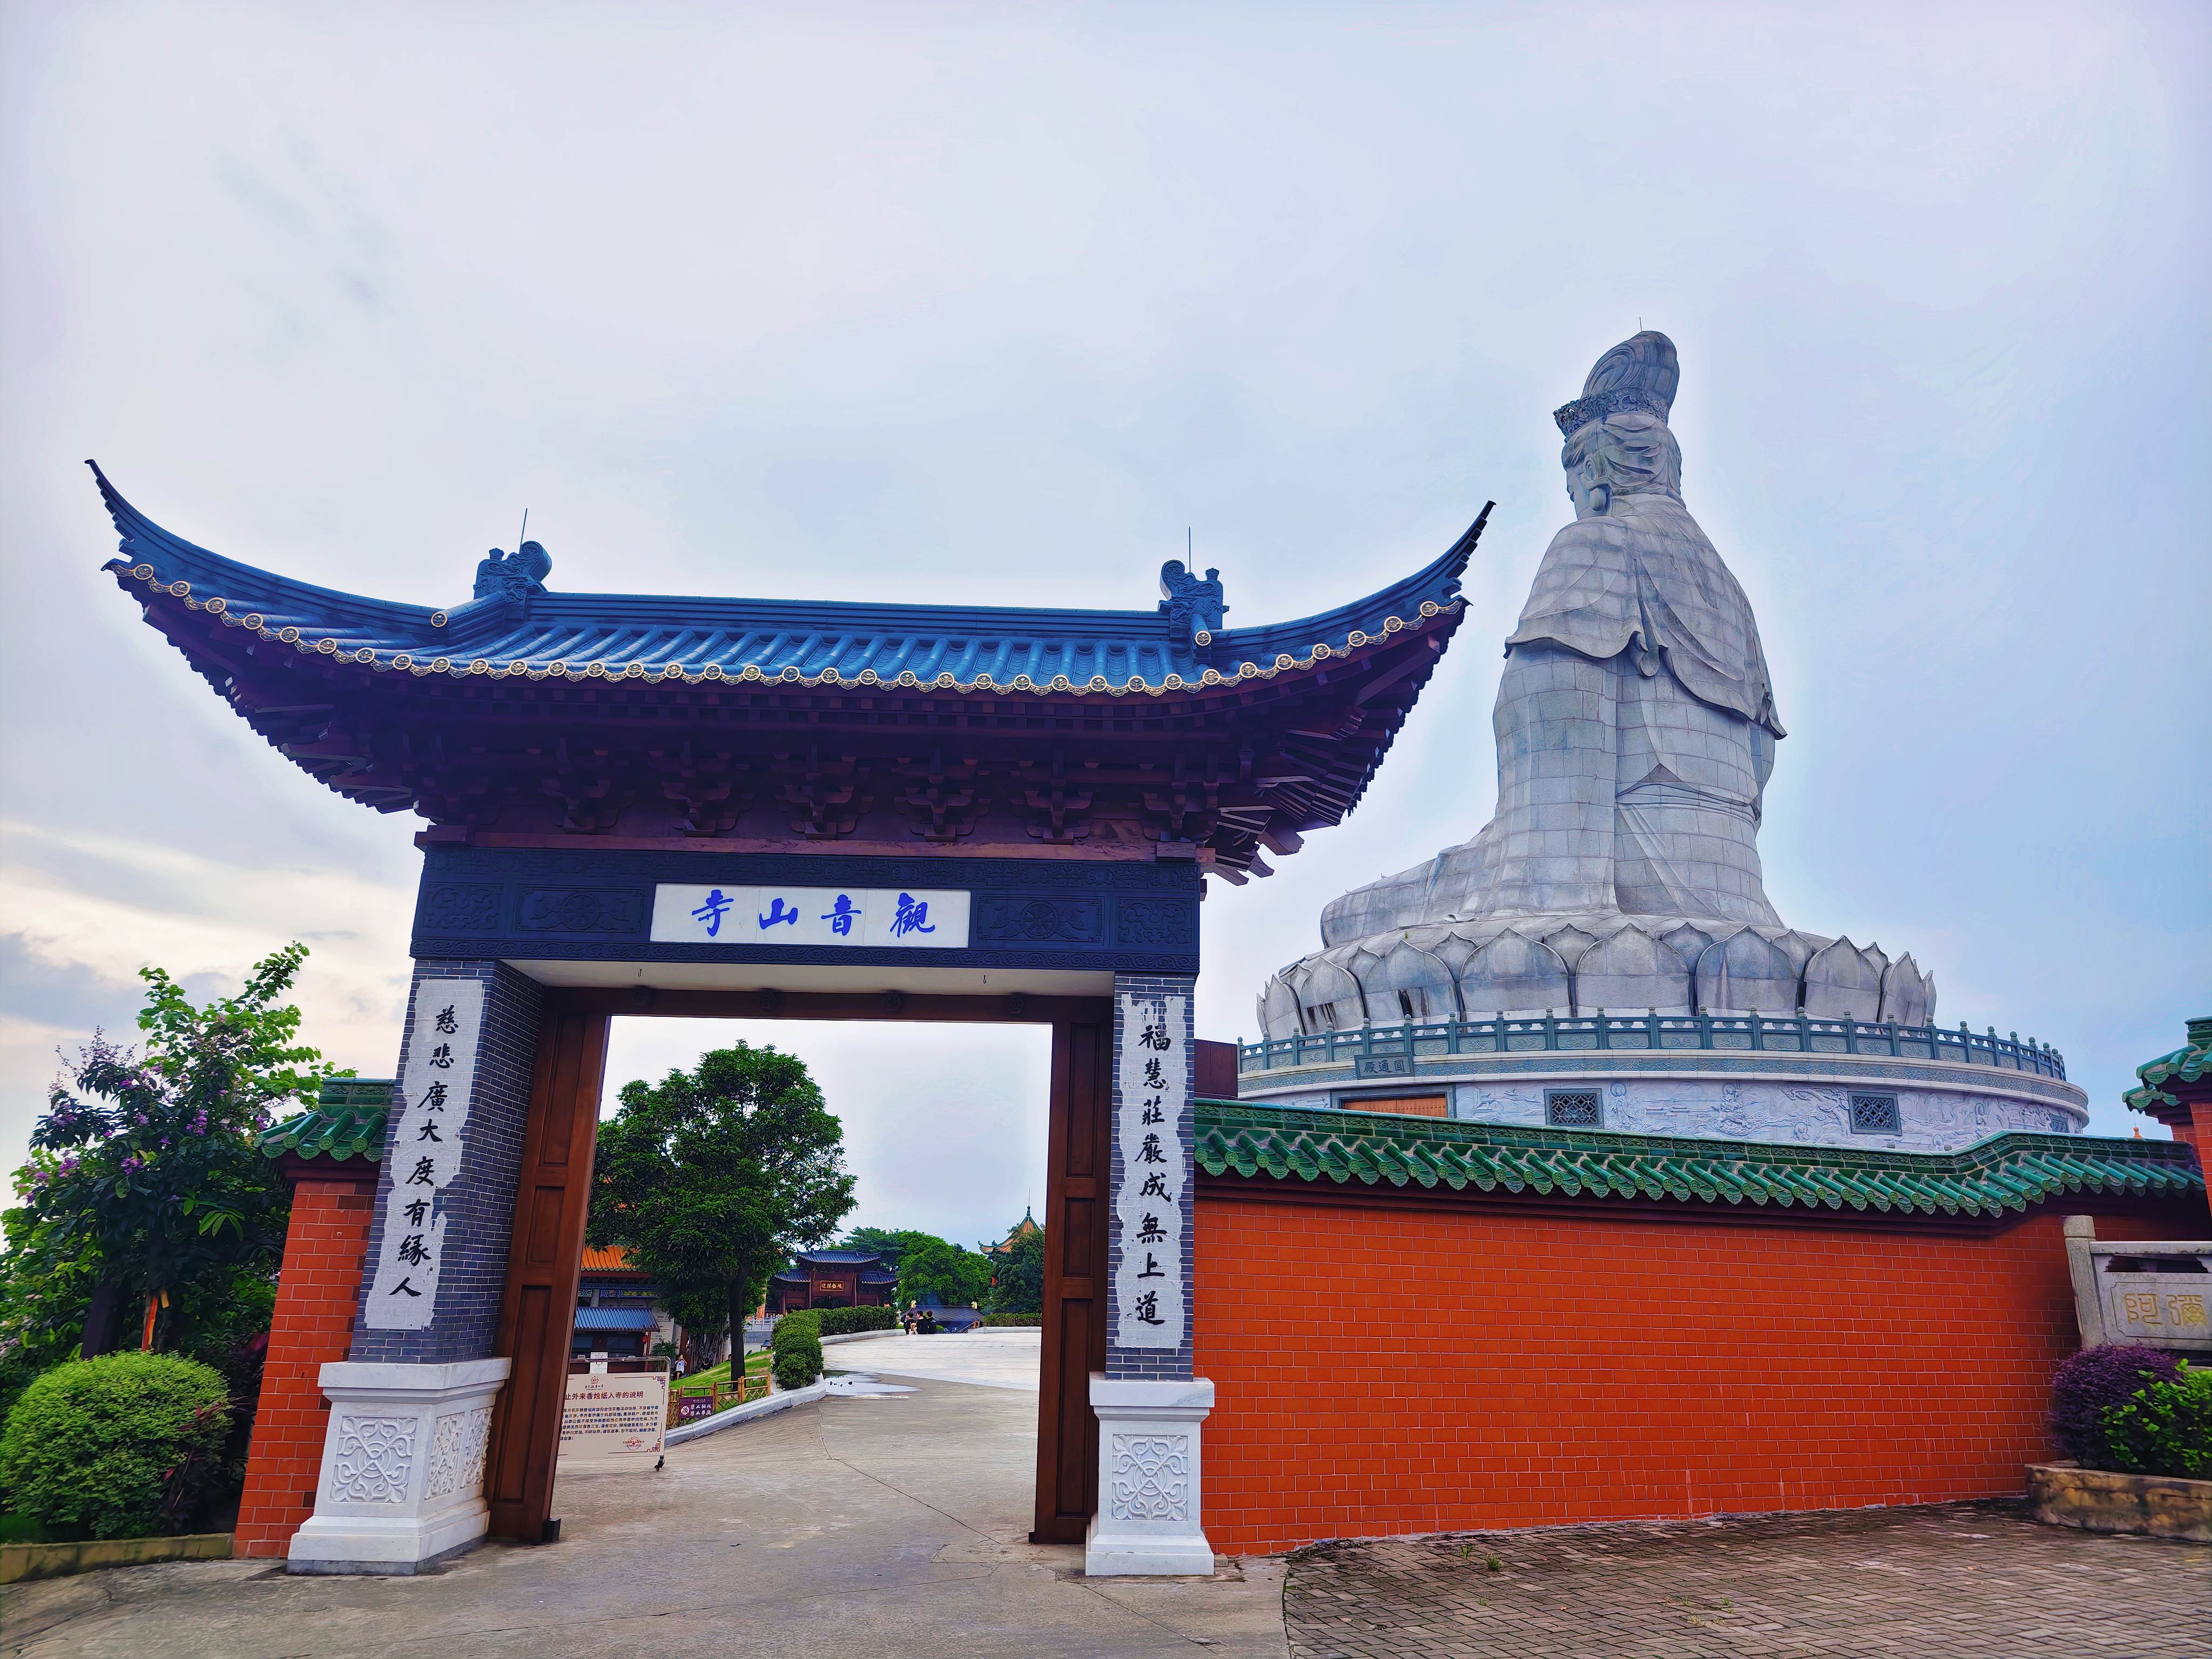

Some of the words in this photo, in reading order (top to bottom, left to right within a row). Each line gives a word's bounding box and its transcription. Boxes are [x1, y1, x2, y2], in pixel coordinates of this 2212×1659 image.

[692, 889, 935, 938] 觀音山寺
[388, 1004, 459, 1297] 慈悲廣大度有緣人
